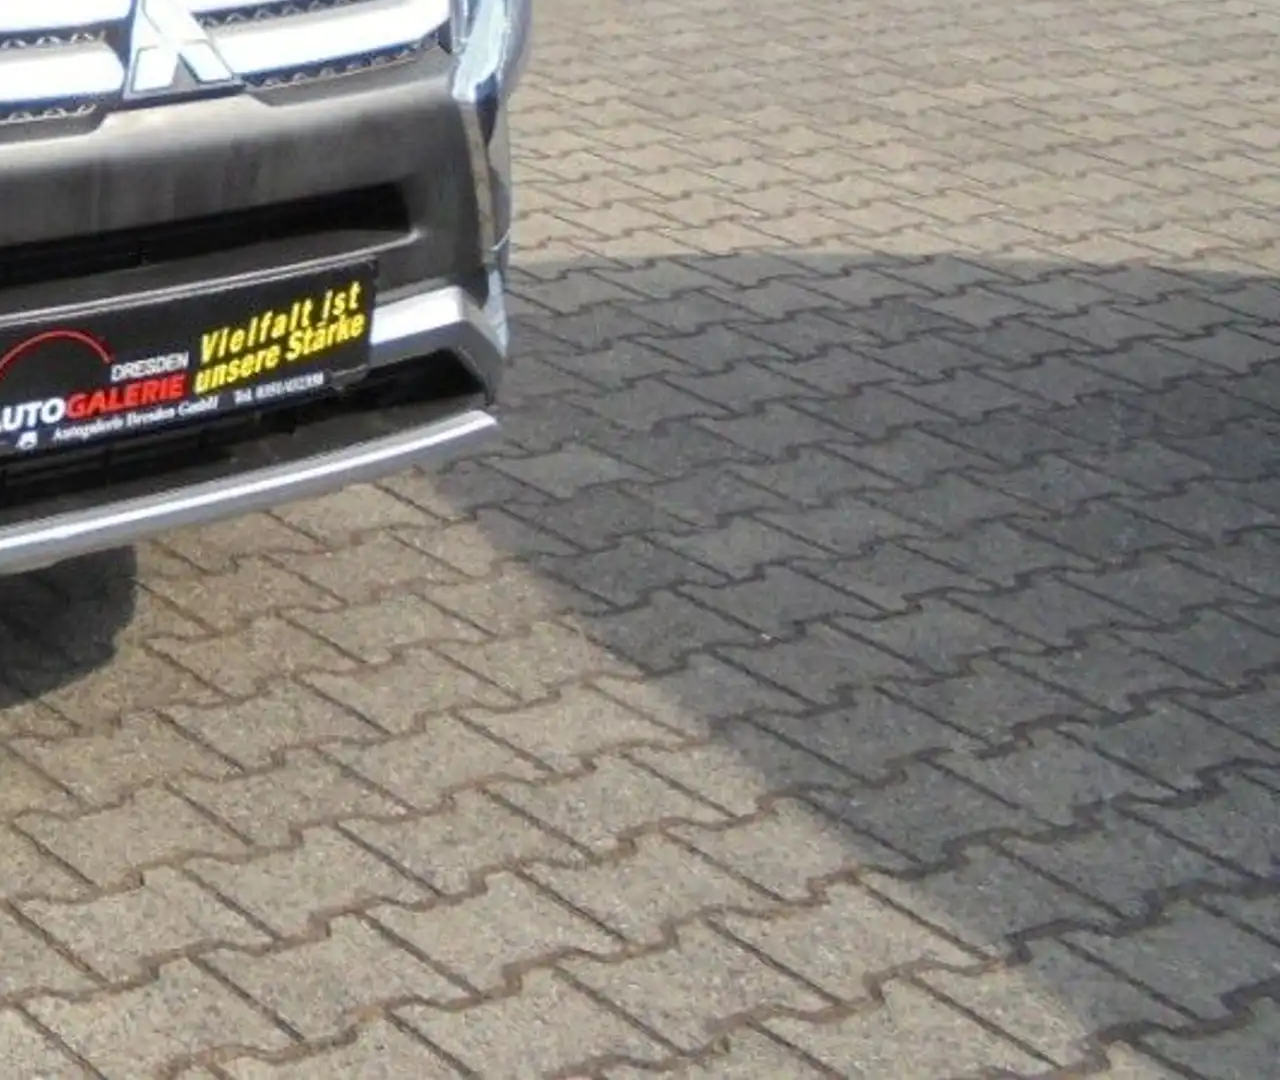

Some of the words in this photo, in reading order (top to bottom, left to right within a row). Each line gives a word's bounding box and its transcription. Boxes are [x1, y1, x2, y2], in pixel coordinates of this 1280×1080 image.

[193, 344, 282, 395] unsere
[285, 312, 366, 362] Stärke
[200, 298, 313, 363] Vielfalt
[321, 280, 362, 322] ist
[110, 351, 190, 382] DRESDEN
